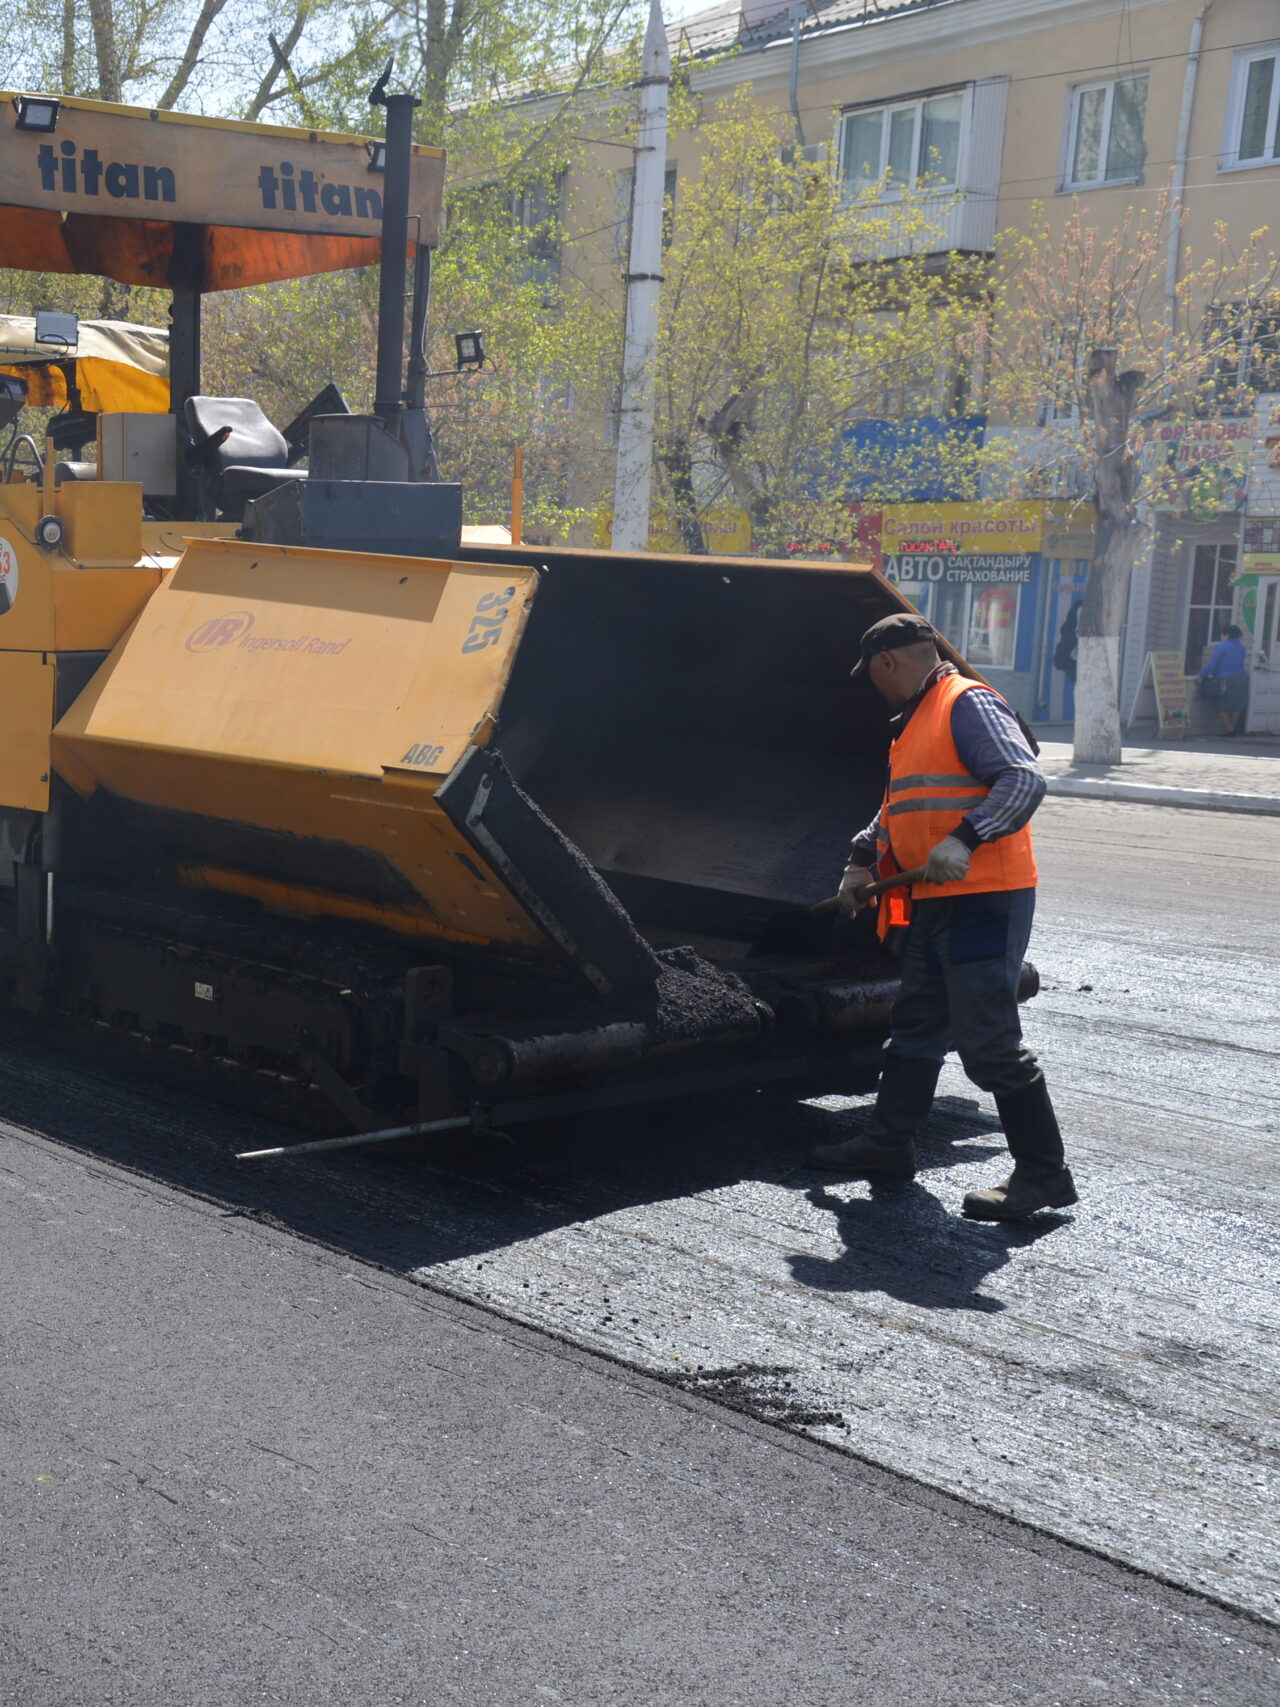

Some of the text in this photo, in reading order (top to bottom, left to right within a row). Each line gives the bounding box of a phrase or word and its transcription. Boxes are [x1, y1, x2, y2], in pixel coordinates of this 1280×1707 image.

[37, 140, 176, 203] titan
[258, 161, 384, 220] titan
[884, 518, 1038, 537] Салон красоты
[884, 555, 1033, 581] АВТО САҚТАНДЫРУ
[946, 570, 1031, 583] СТРАХОВАНИЕ
[461, 586, 516, 655] 325
[237, 633, 307, 653] Ingersoll
[304, 637, 354, 656] Rand
[399, 743, 445, 767] ABG
